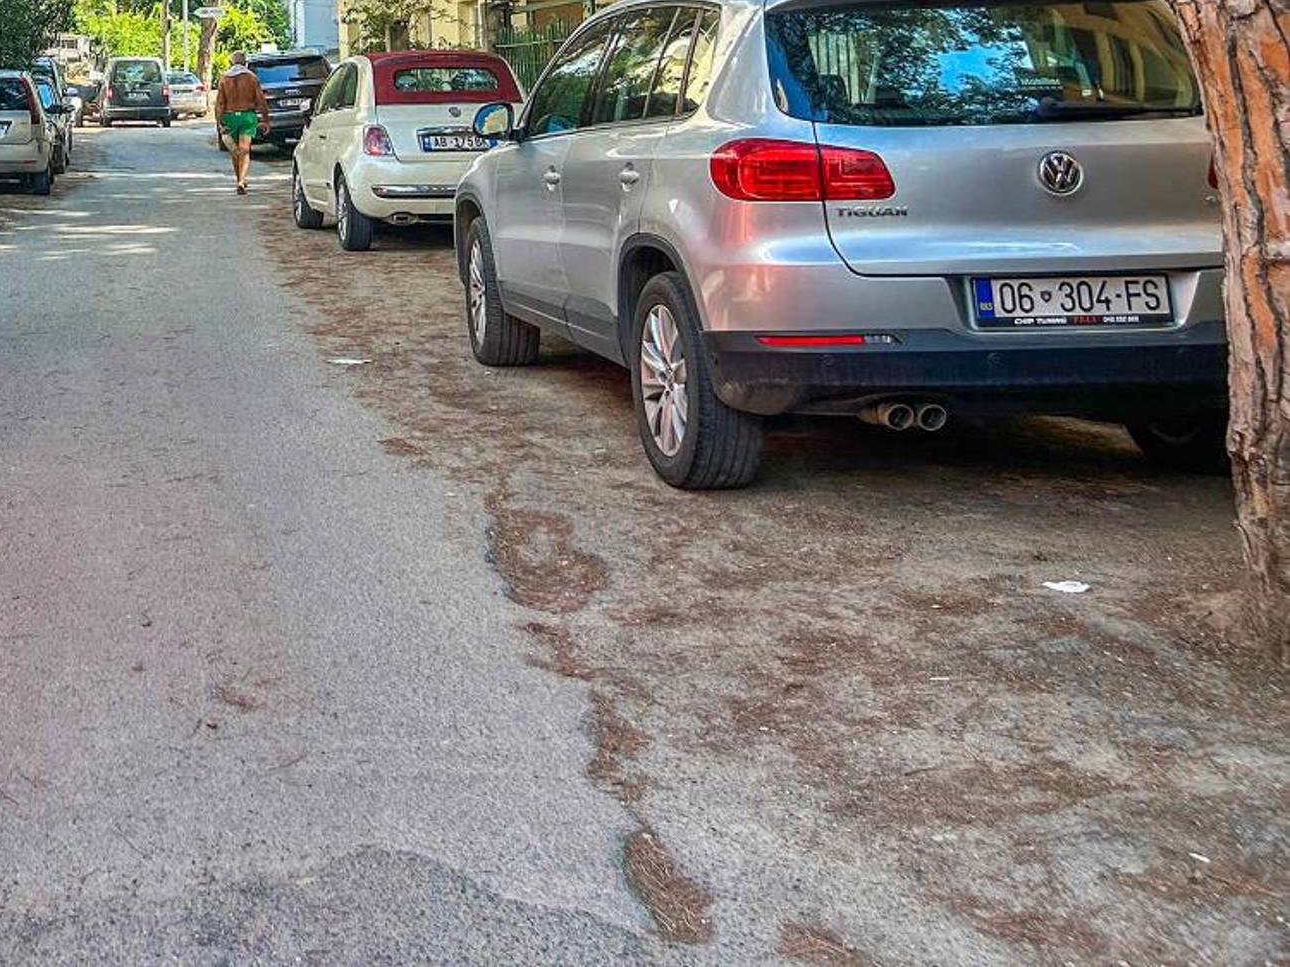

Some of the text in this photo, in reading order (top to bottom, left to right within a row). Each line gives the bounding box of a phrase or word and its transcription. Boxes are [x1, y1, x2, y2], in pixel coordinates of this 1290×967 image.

[837, 206, 909, 217] TIGUAN
[998, 279, 1161, 314] 06 304-FS
